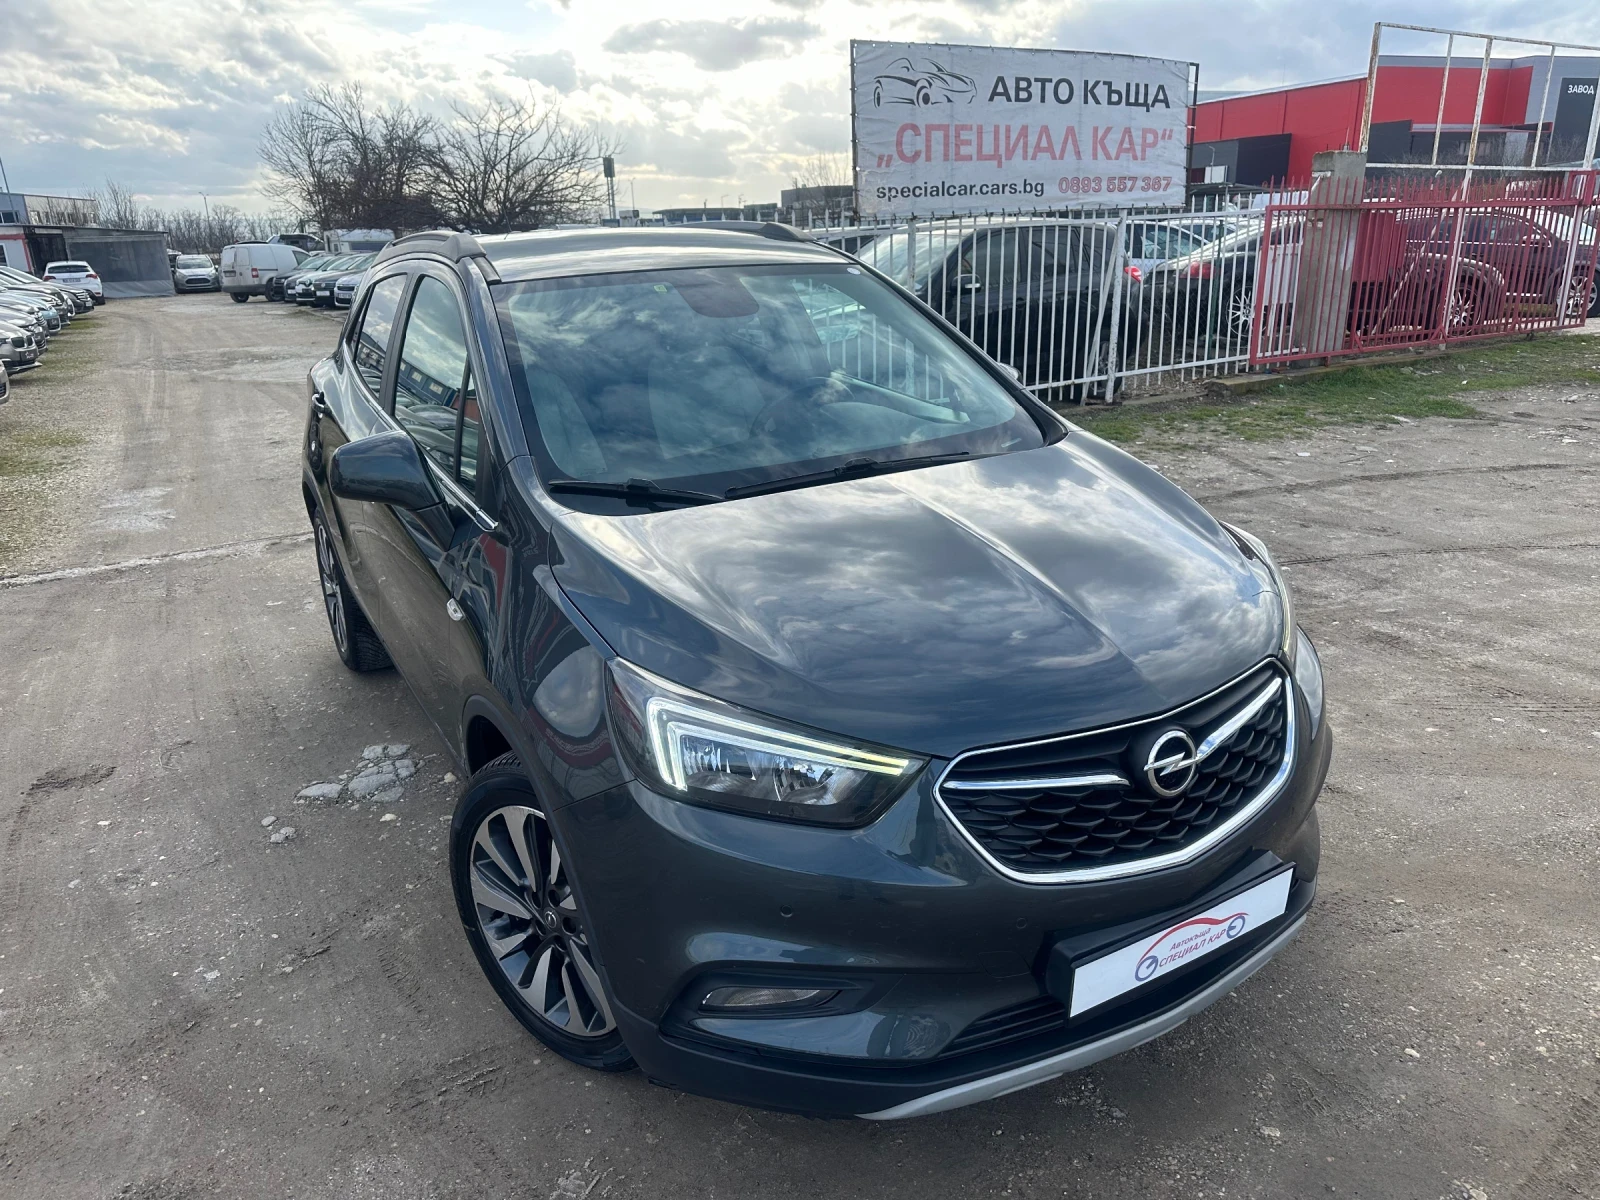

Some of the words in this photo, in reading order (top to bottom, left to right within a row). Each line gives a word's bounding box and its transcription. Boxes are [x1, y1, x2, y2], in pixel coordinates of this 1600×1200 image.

[988, 75, 1075, 105] АВТО
[1083, 79, 1171, 113] КЪЩА
[1567, 84, 1595, 95] ЗАВОД
[876, 178, 1045, 203] specialcar.cars.bg
[1058, 176, 1103, 194] 0893
[1106, 176, 1138, 193] 557
[1141, 176, 1173, 193] 367
[1159, 939, 1207, 968] СПЕЦИАЛ
[1207, 928, 1227, 945] КАР
